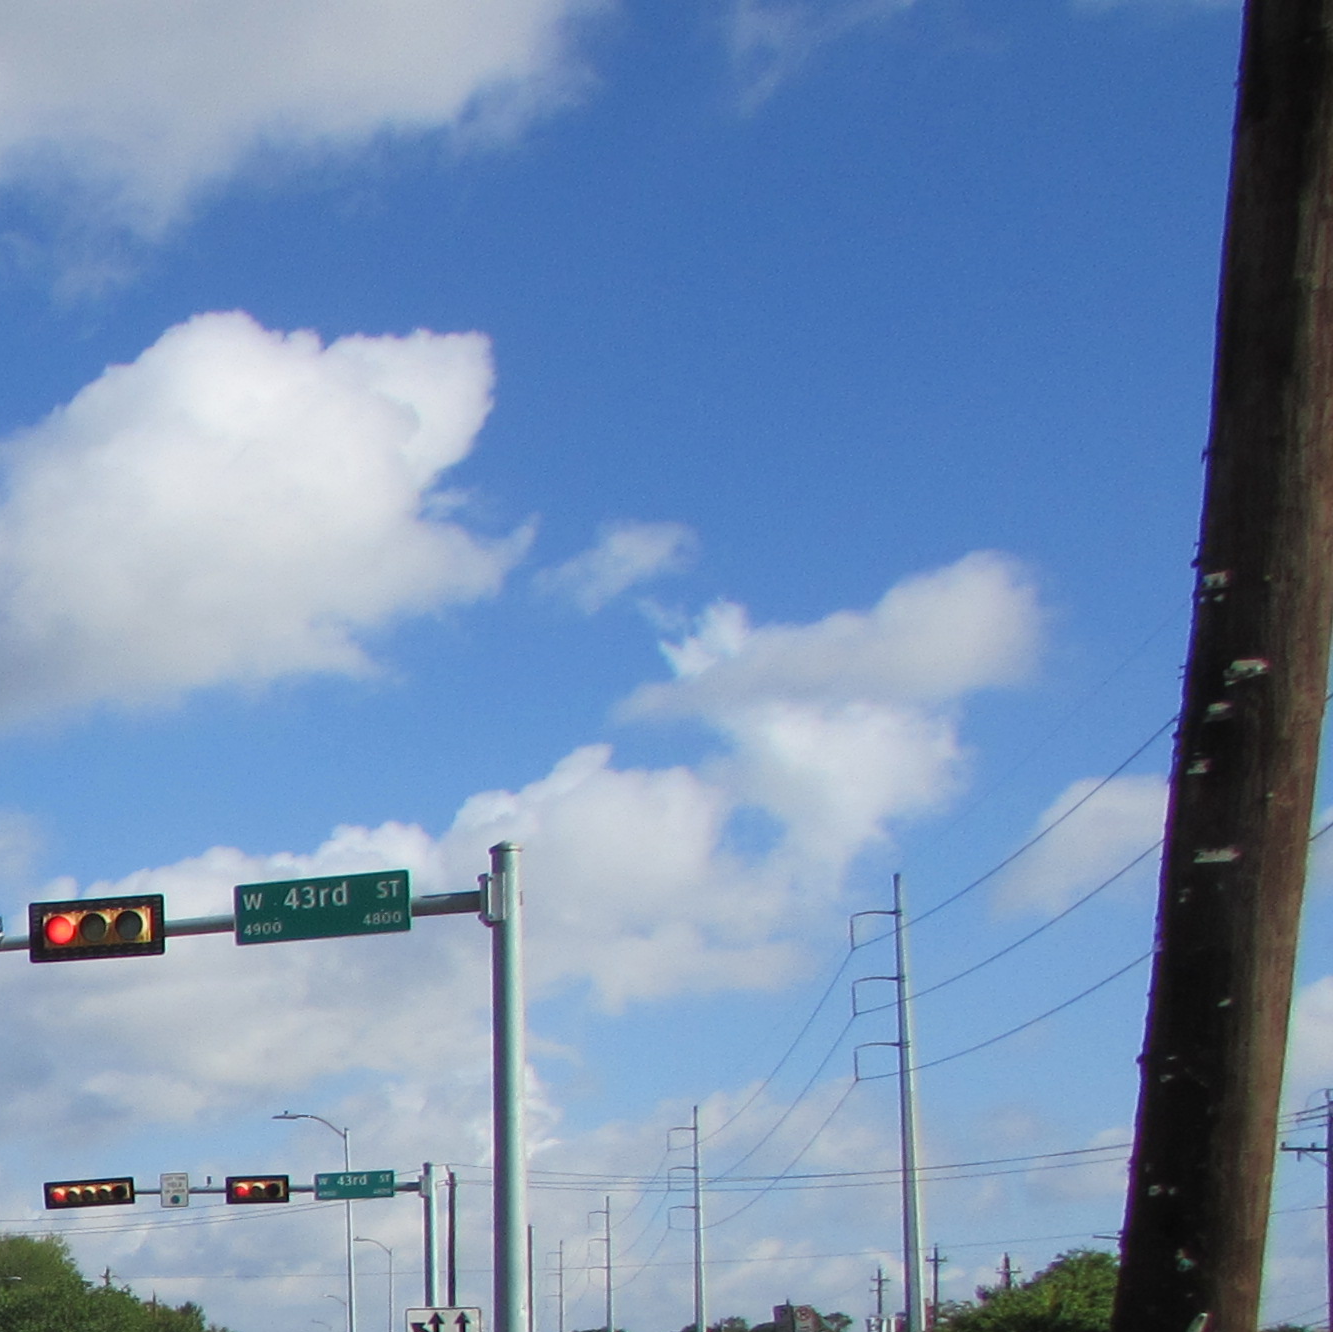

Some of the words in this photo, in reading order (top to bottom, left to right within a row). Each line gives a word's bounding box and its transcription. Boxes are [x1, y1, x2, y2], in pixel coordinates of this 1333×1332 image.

[243, 893, 263, 911] W
[283, 881, 349, 910] 43rd
[376, 880, 401, 899] ST
[243, 921, 282, 936] 4900
[362, 911, 402, 926] 4800
[336, 1174, 367, 1186] 43rd
[379, 1173, 392, 1182] ST
